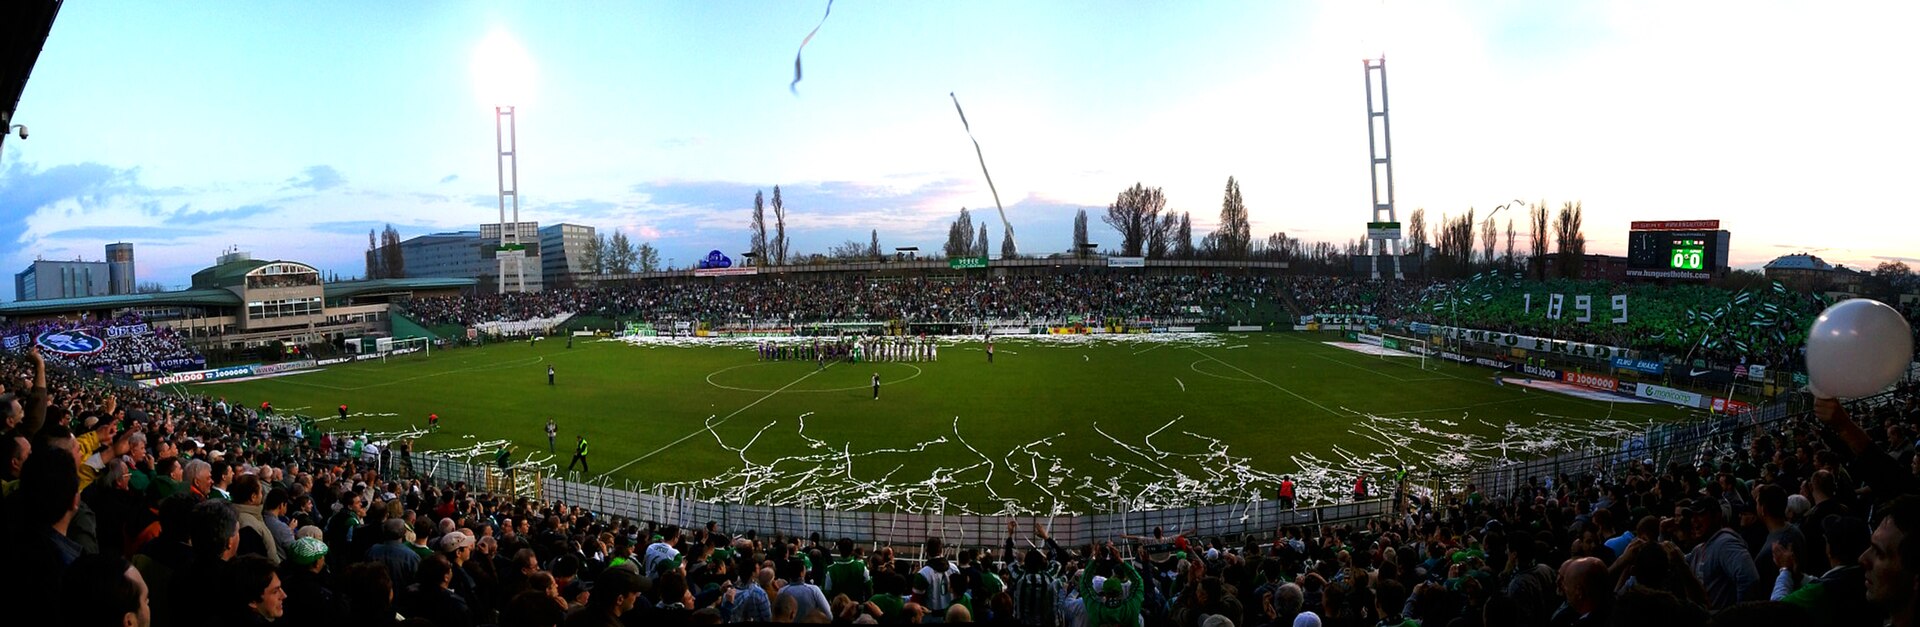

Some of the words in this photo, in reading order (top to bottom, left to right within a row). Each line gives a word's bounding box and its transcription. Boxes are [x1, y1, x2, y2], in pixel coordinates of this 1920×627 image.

[1674, 253, 1684, 268] 0
[1690, 253, 1700, 269] 0
[1626, 270, 1711, 279] www.hunguesthotels.com
[1523, 293, 1628, 324] 1899
[1444, 327, 1519, 346] TEMPO
[1576, 374, 1614, 389] 1000000
